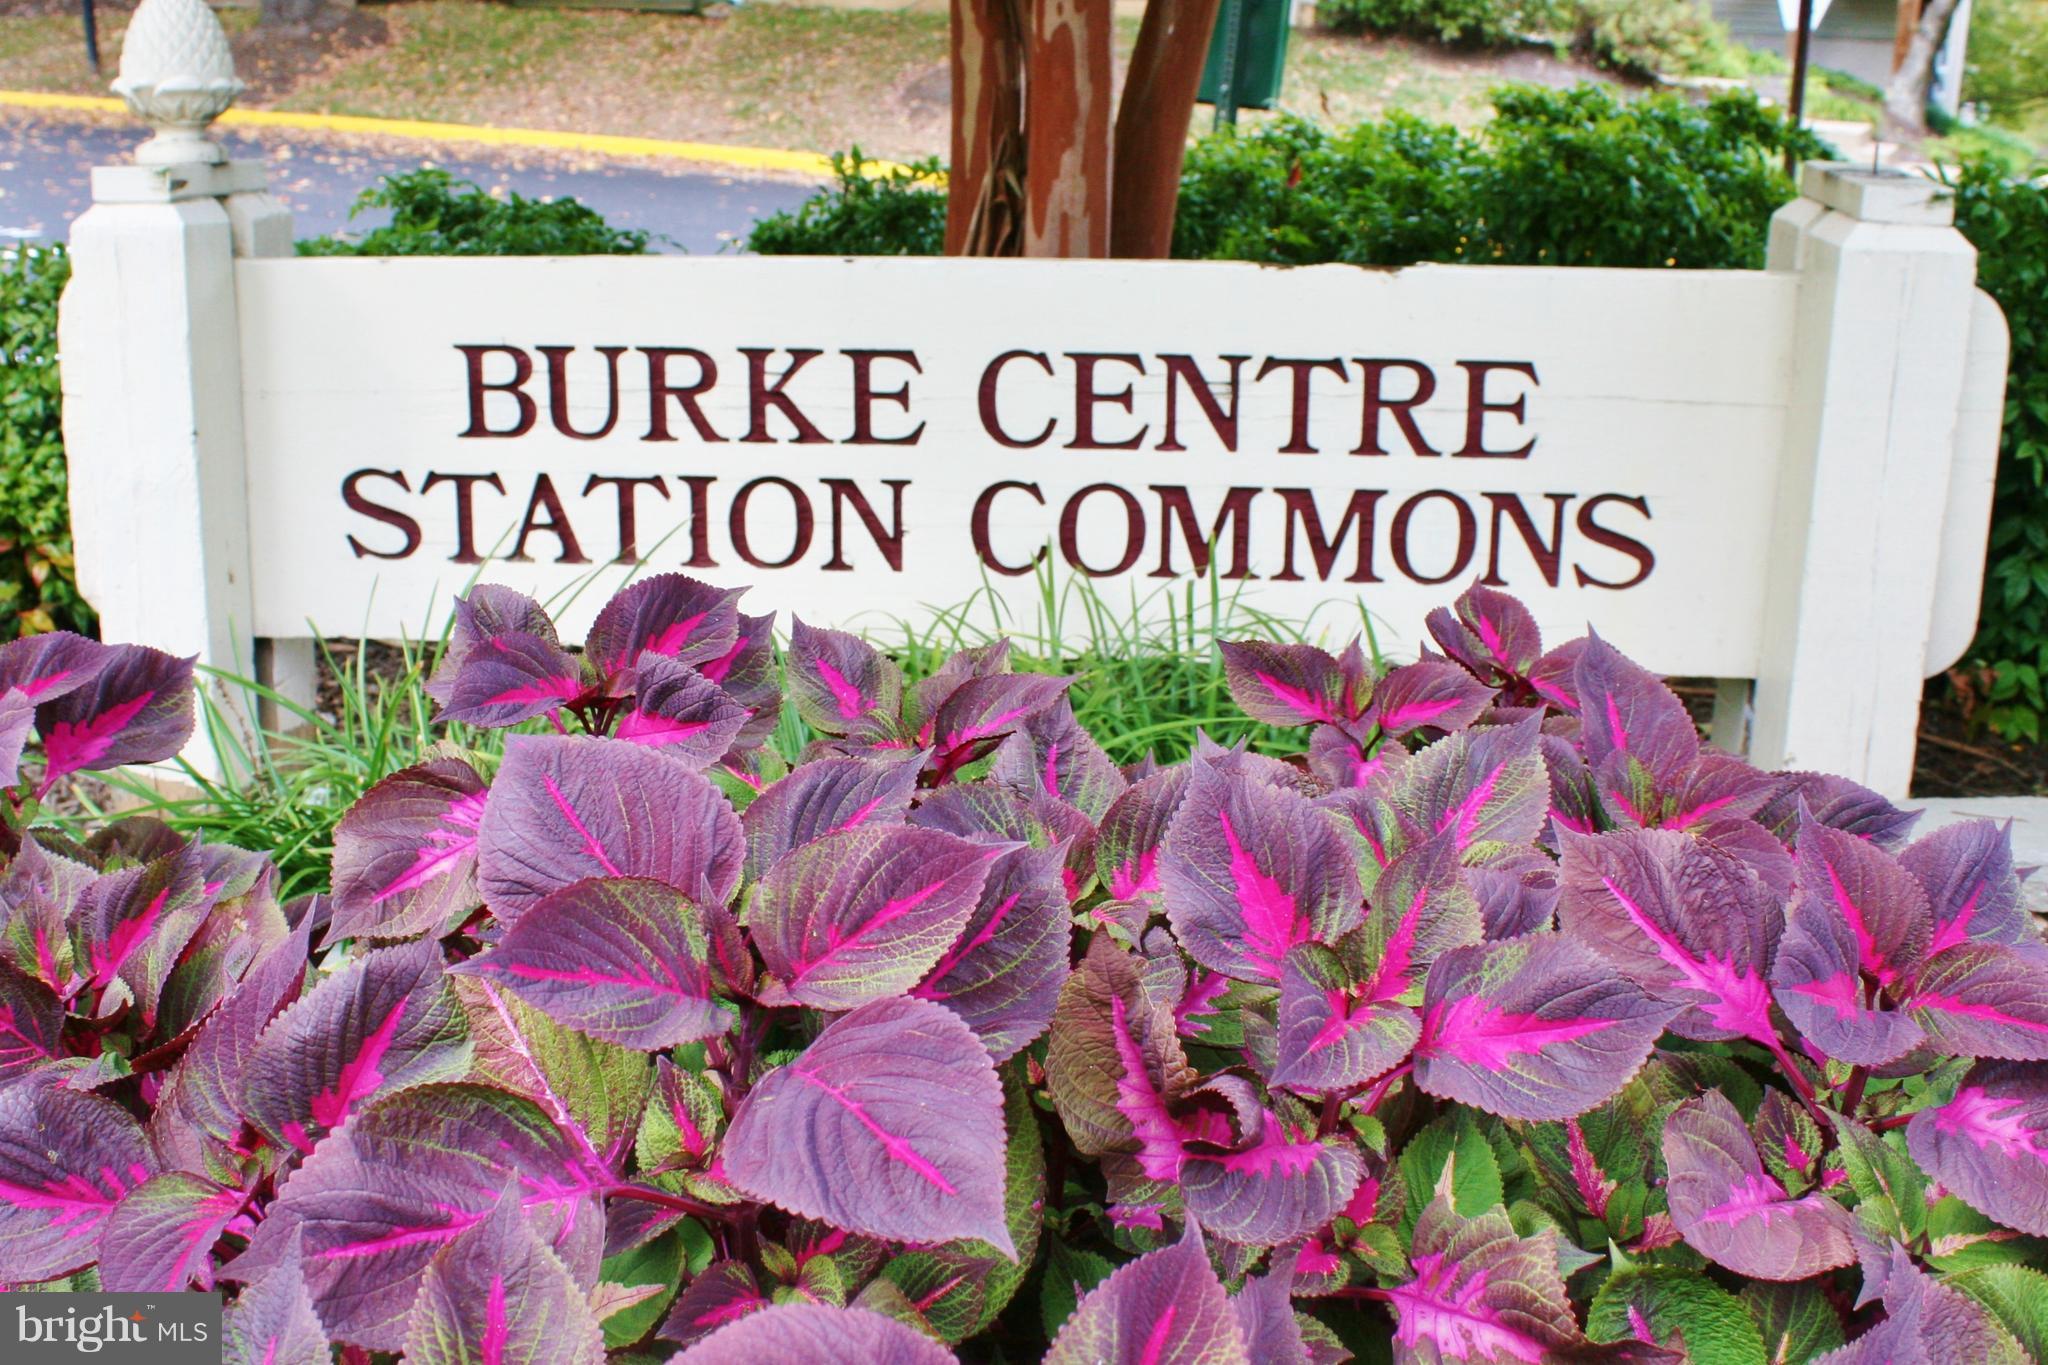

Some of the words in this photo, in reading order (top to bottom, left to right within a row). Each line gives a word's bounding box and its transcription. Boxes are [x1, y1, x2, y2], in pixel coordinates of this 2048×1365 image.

[452, 343, 928, 446] BURKE
[977, 349, 1541, 460] CENTRE
[340, 467, 913, 572] STATION
[970, 479, 1657, 590] COMMONS
